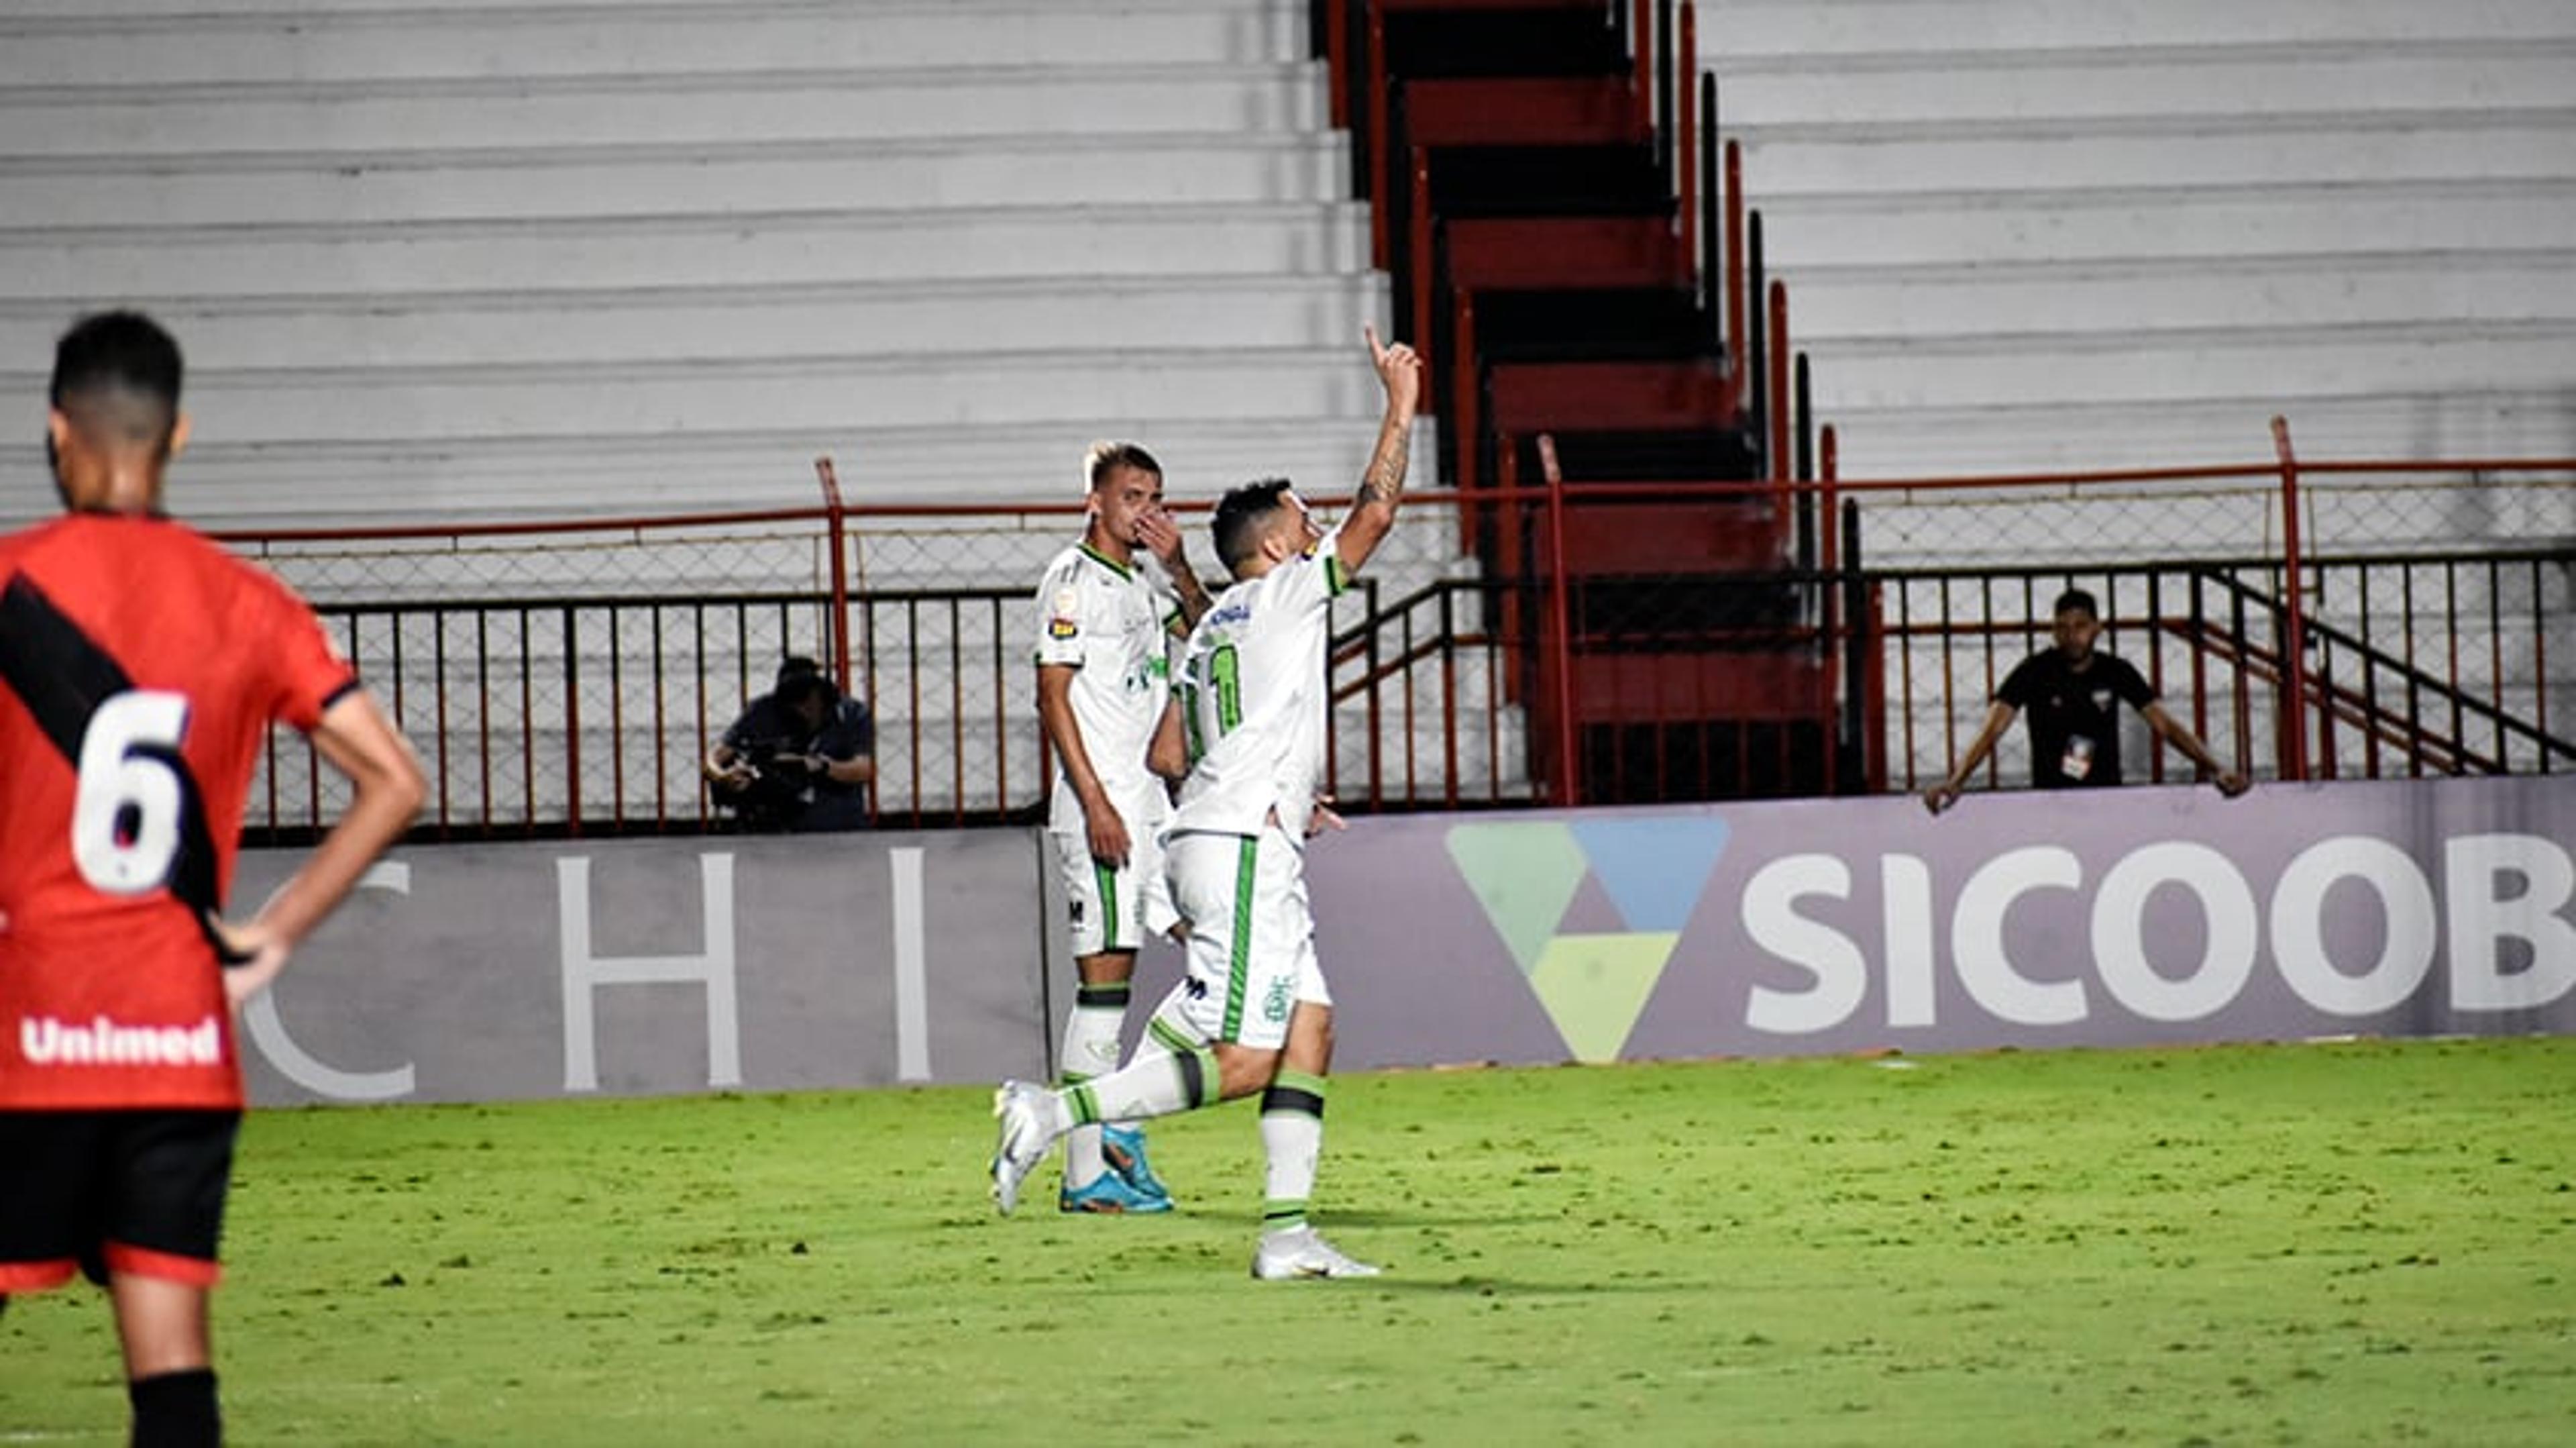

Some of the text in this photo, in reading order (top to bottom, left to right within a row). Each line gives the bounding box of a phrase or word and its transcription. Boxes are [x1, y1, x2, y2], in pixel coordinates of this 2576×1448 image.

[72, 690, 190, 896] 6
[1741, 833, 2576, 1034] SICOOB
[21, 1015, 219, 1064] Unimed
